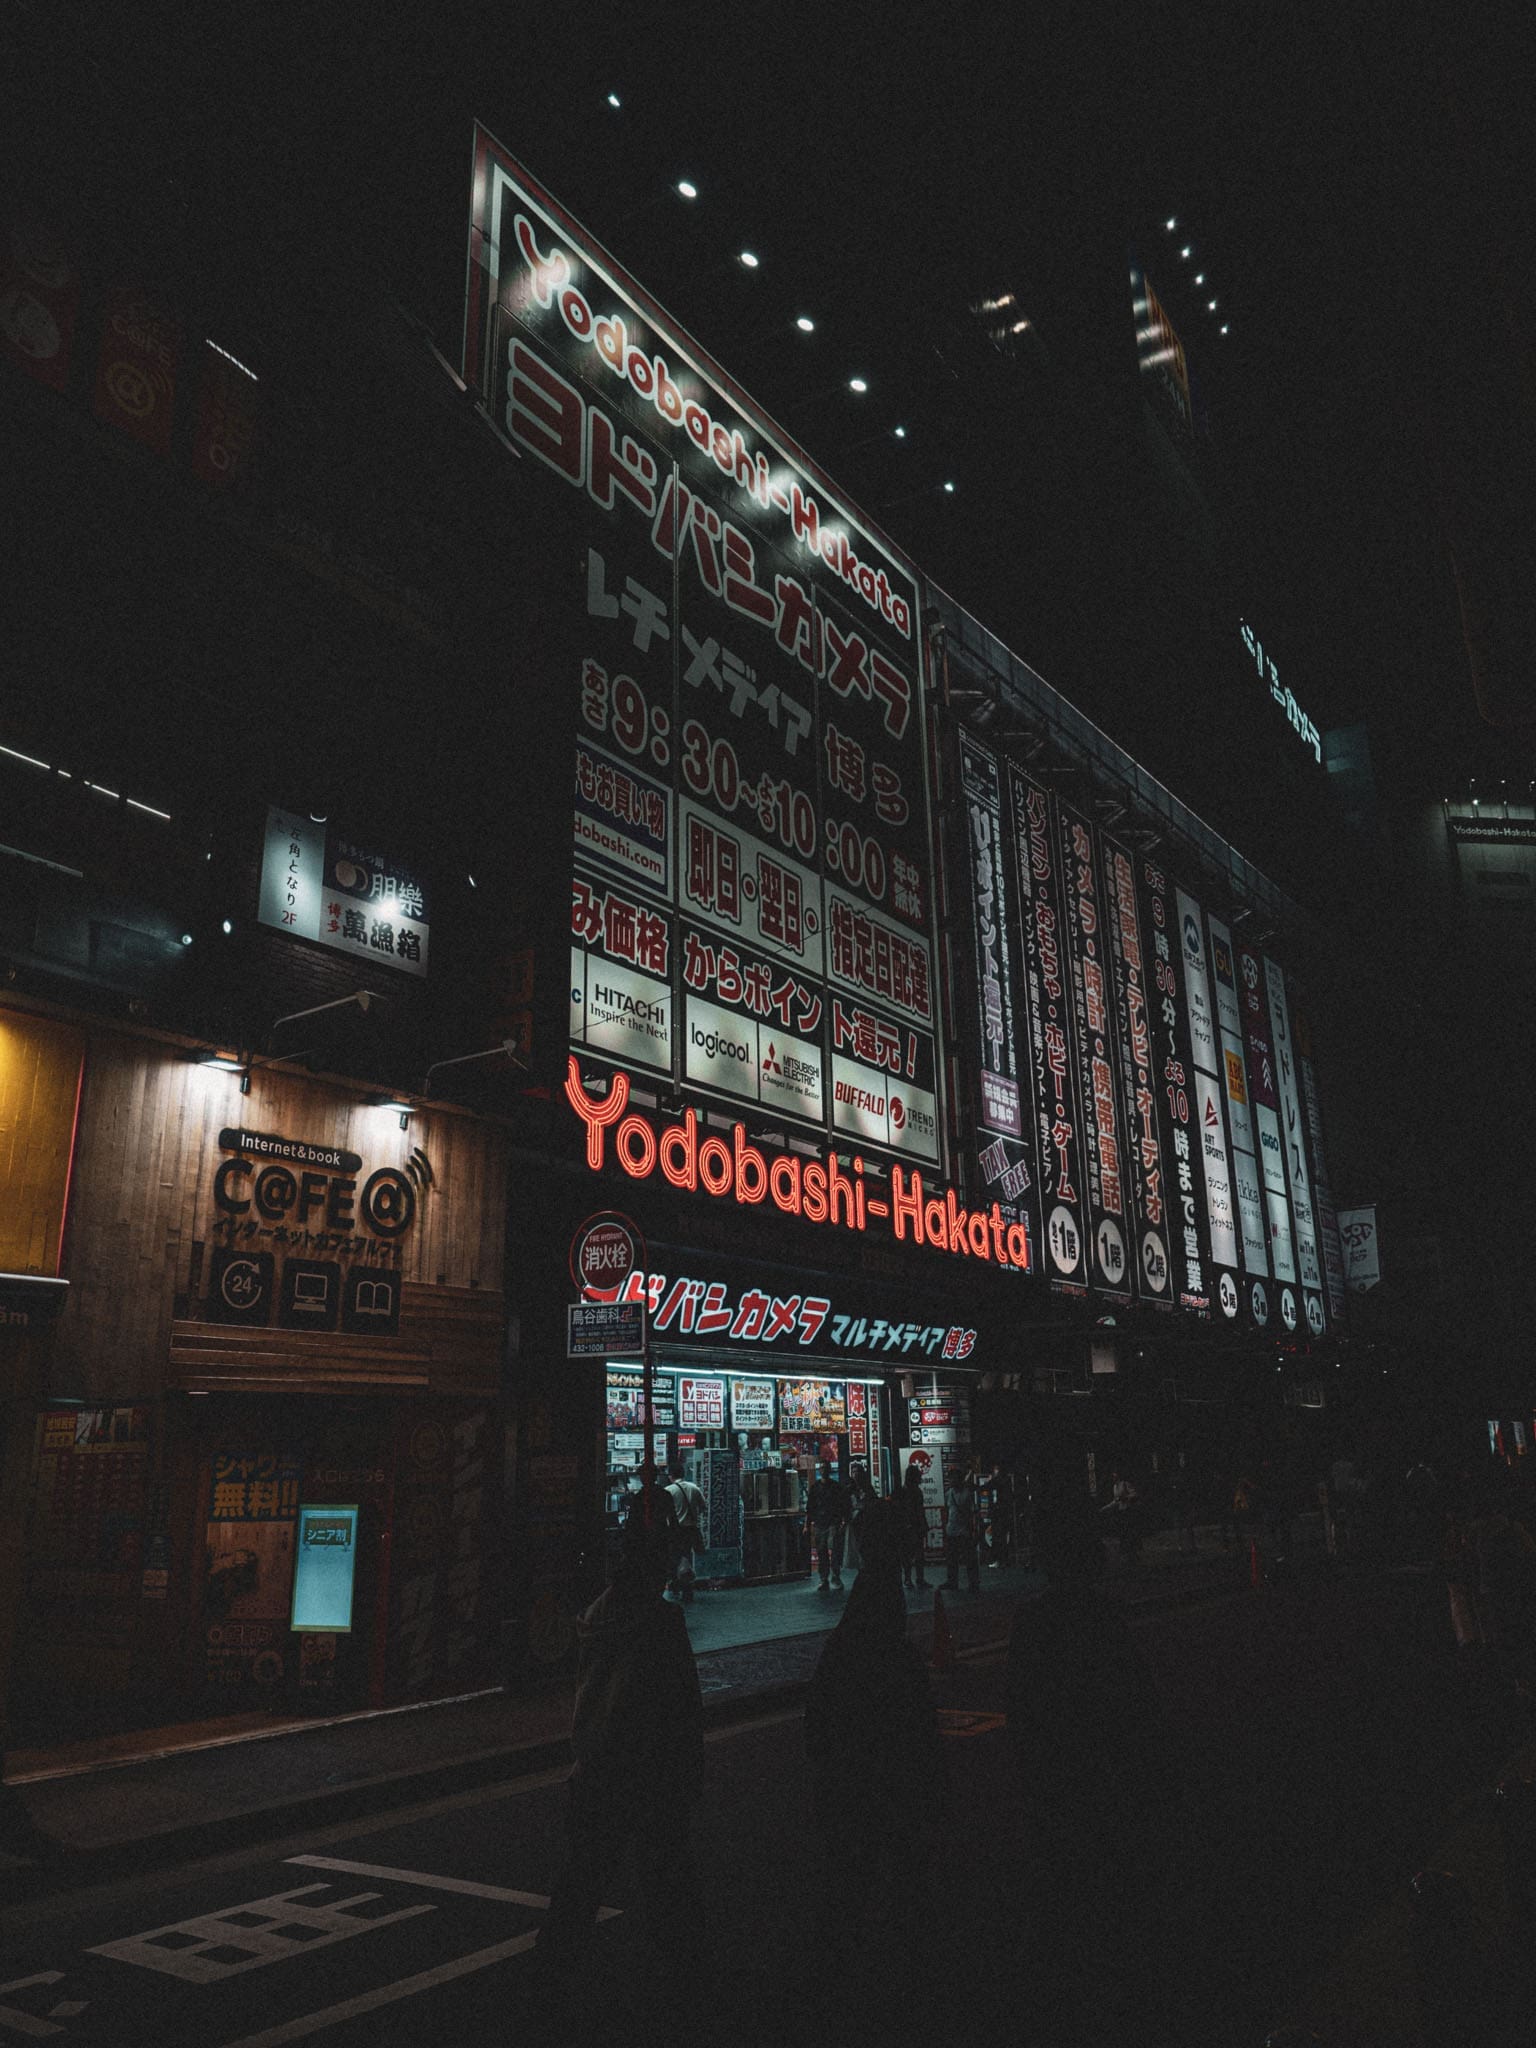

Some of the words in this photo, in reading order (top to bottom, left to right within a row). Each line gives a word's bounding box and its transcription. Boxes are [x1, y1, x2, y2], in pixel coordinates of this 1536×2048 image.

[513, 213, 912, 640] Yodobashi-Hakata
[506, 337, 910, 740] ヨドバシカメラ
[824, 722, 909, 826] 博多
[281, 911, 297, 926] 2F
[590, 1003, 626, 1030] Inspire
[627, 1013, 645, 1032] the
[646, 1022, 669, 1043] Next
[594, 983, 665, 1025] HITACHI
[691, 1021, 750, 1064] logicool
[783, 1054, 821, 1078] MITSUBISHI
[783, 1068, 817, 1088] ELECTRIC
[907, 1108, 935, 1129] TREND
[240, 1132, 342, 1167] Internet&book
[562, 1053, 1031, 1273] Yodobashi-Hakata
[978, 1138, 1011, 1186] TAX
[213, 1157, 357, 1229] C@FE
[1000, 1159, 1031, 1201] FREE
[584, 1242, 629, 1272] 消火栓
[1102, 1230, 1122, 1270] 1階
[1144, 1244, 1166, 1278] 2階
[231, 1275, 253, 1293] 24
[581, 1269, 833, 1347] ドバシカメラ
[830, 1313, 946, 1355] マルチメディア
[941, 1324, 978, 1361] 博多
[212, 1479, 299, 1518] 無料!!
